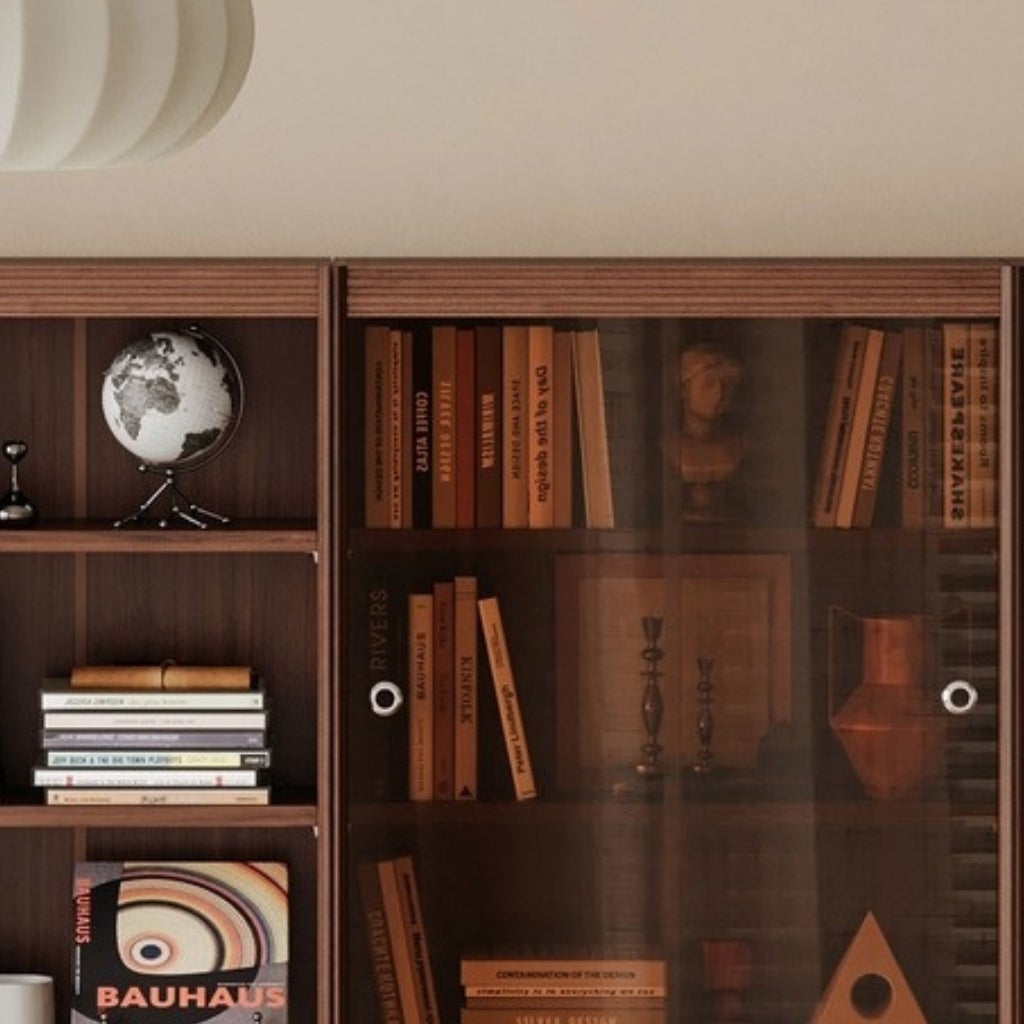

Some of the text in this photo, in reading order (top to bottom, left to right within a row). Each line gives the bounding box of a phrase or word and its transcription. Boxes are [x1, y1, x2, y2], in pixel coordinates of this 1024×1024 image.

[369, 588, 388, 671] RIVERS
[416, 632, 426, 700] BAUHAUS
[460, 656, 473, 724] KINFOLK
[76, 877, 91, 944] BAUHAUS
[97, 986, 285, 1008] BAUHAUS
